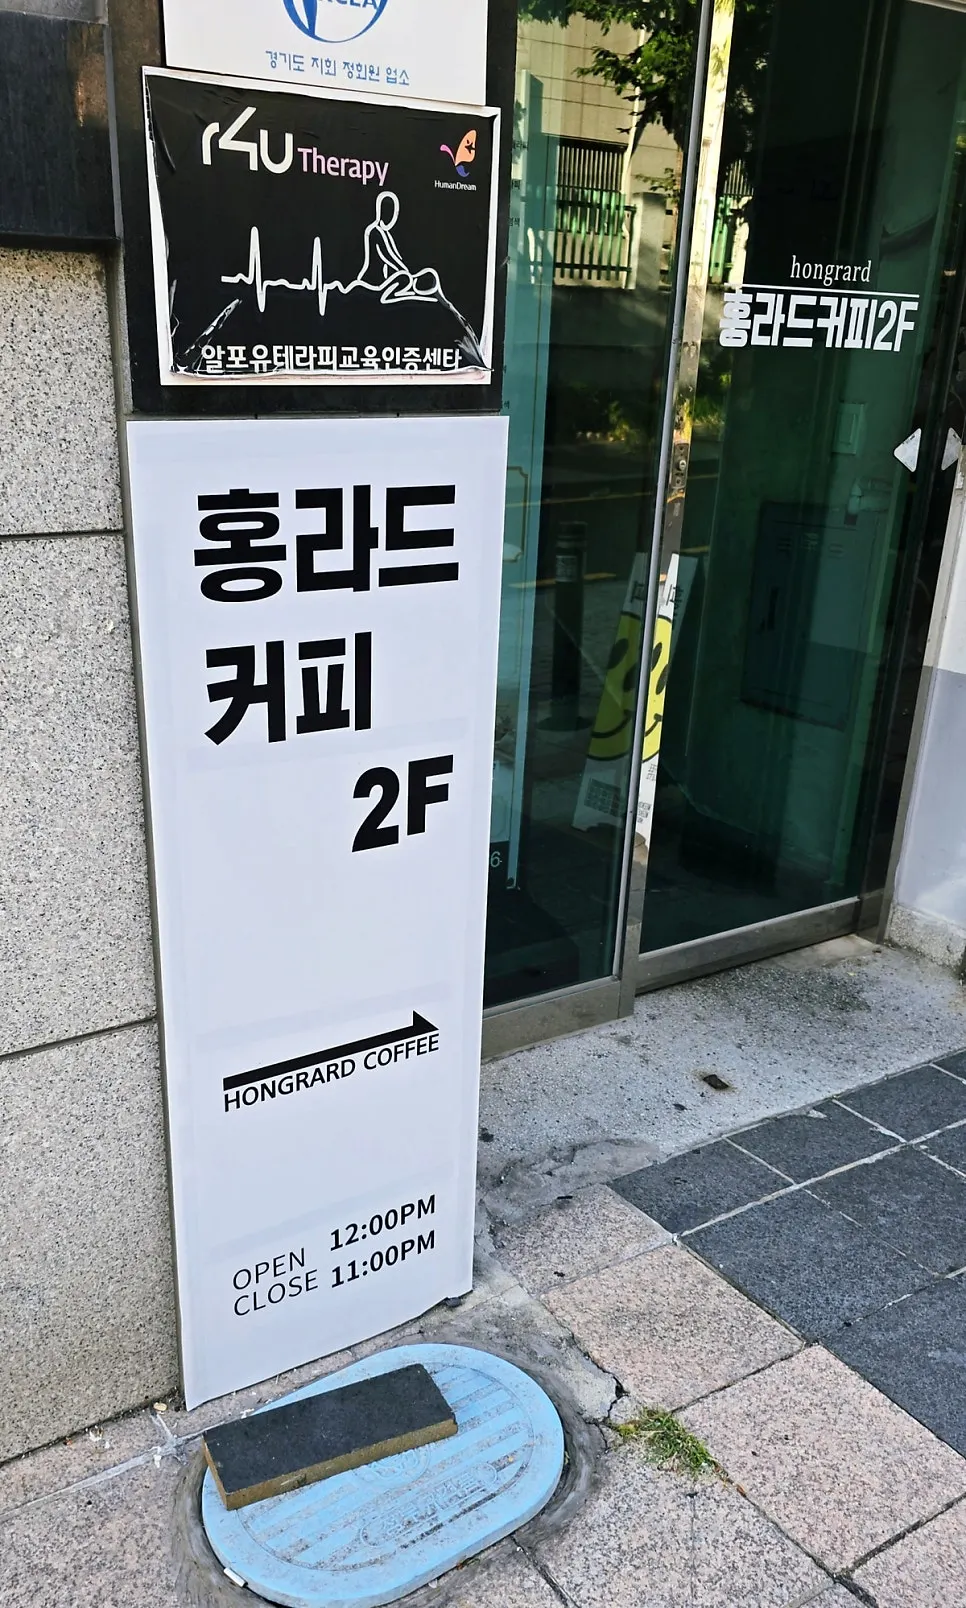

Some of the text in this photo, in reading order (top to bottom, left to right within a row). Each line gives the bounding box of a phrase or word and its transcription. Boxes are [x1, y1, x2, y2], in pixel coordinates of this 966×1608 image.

[265, 51, 410, 86] 경기도 지회 정회원 업소
[297, 147, 389, 187] Therapy
[434, 180, 477, 191] HumanDream
[790, 255, 872, 287] hongrard
[202, 345, 462, 374] 알포유테라피교육인증센타
[194, 484, 459, 602] 홍라드
[204, 631, 372, 745] 커피
[352, 754, 454, 852] 2F
[224, 1033, 439, 1113] HONGRARD COFFEE
[232, 1194, 436, 1290] OPEN 12:00PM
[234, 1229, 436, 1316] CLOSE 11:00PM
